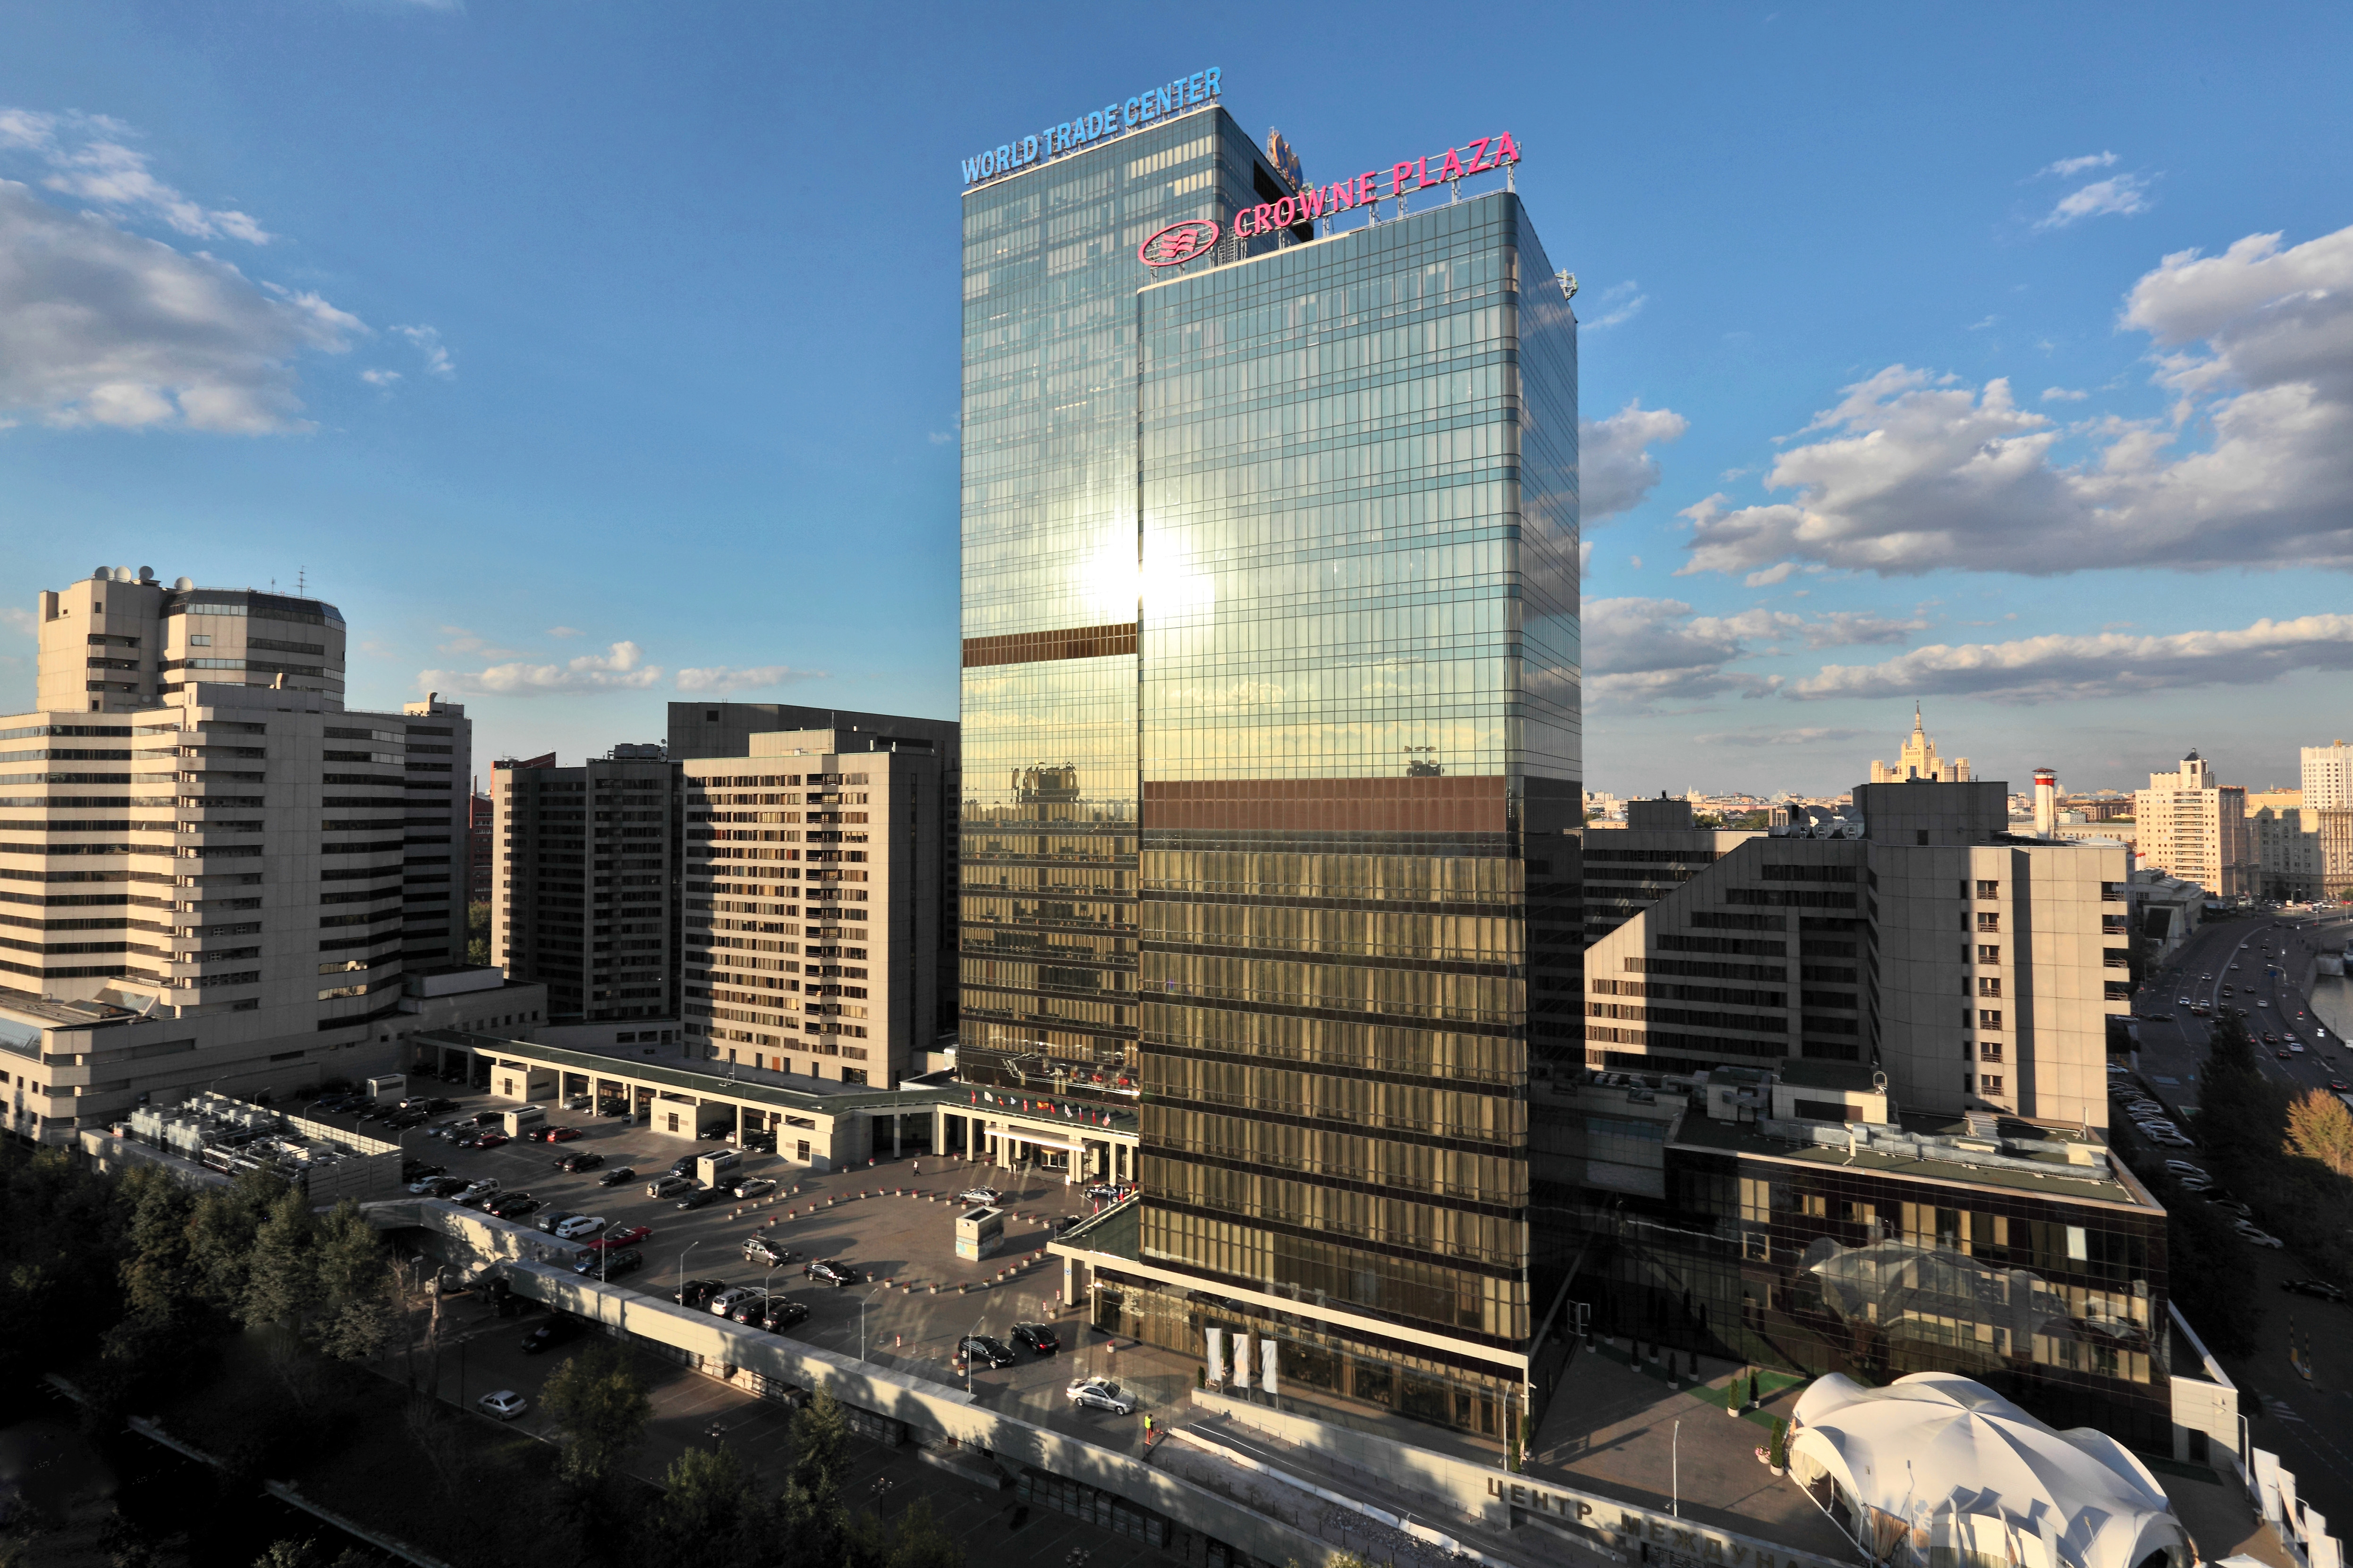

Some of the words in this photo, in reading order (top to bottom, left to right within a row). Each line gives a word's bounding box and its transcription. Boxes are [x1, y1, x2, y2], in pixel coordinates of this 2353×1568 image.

[961, 135, 1038, 185] WORLD
[1043, 103, 1118, 155] TRADE
[1123, 67, 1222, 126] CENTER
[1234, 170, 1377, 237] CROWNE
[1392, 131, 1519, 194] PLAZA
[1488, 1477, 1592, 1520] ЦЕНТР
